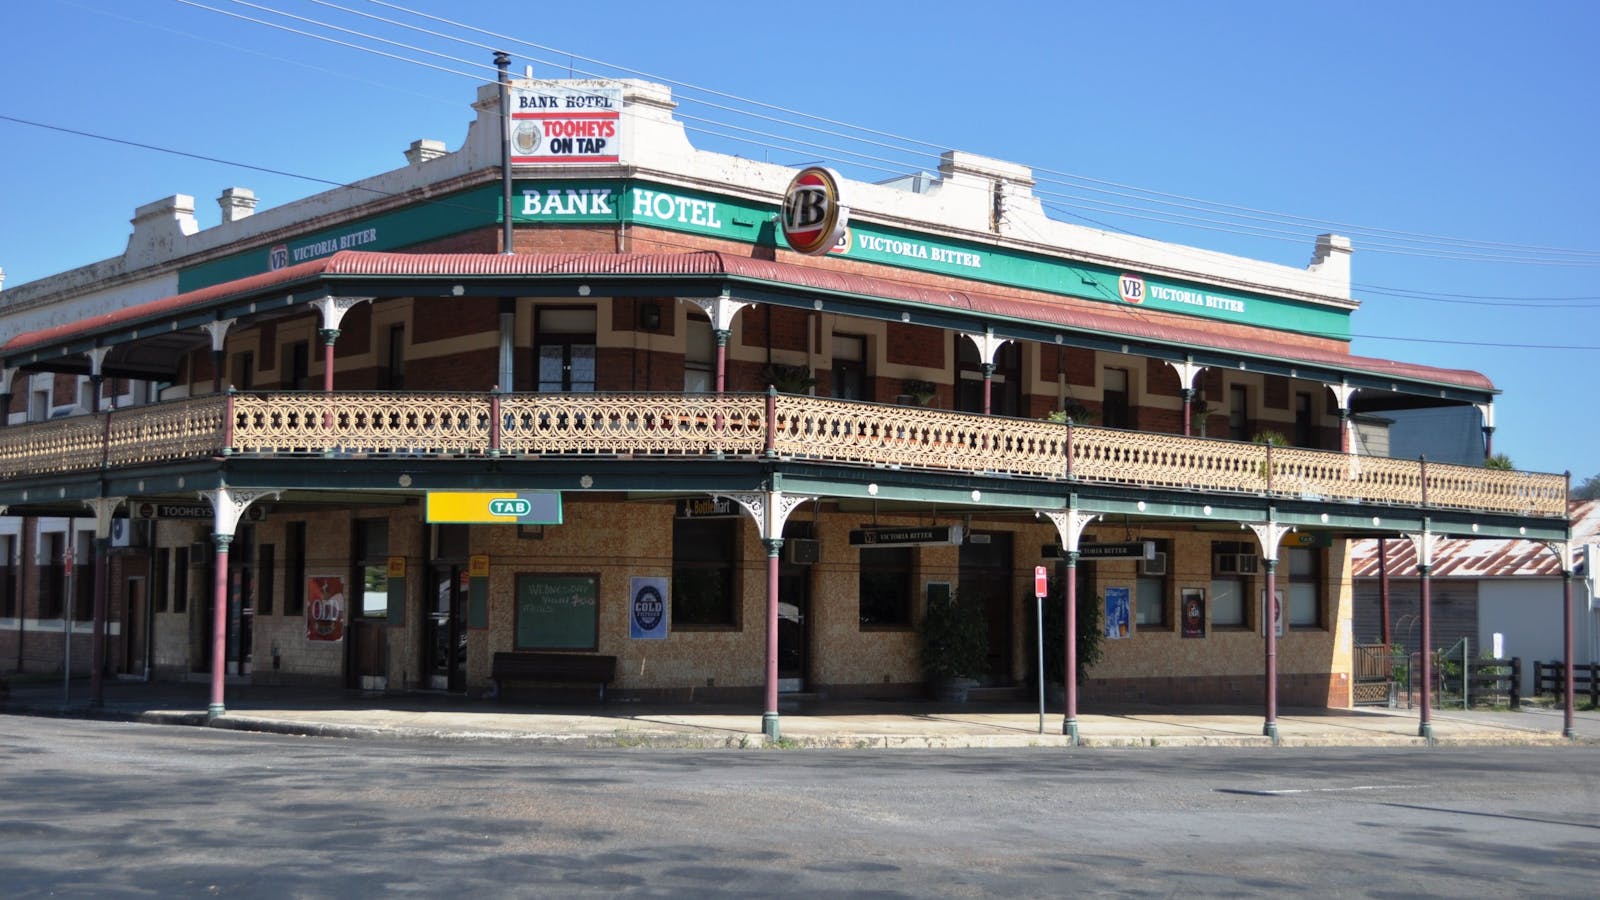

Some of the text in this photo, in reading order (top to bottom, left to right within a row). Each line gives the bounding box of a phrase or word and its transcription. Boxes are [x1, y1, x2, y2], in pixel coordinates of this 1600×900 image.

[519, 96, 613, 108] BANK HOTEL
[542, 120, 615, 138] TOOHEYS
[550, 138, 607, 154] ON TAP
[521, 187, 722, 229] BANK HOTEL
[785, 188, 826, 228] VB
[293, 228, 377, 261] VICTORIA BITTER
[858, 234, 982, 268] VICTORIA BITTER
[1122, 280, 1142, 297] VB
[1150, 285, 1245, 313] VICTORIA BITTER
[163, 506, 213, 517] TOOHEYS
[495, 502, 526, 513] TAB
[880, 531, 933, 541] VICTORIA BITTER
[635, 602, 662, 612] COLD
